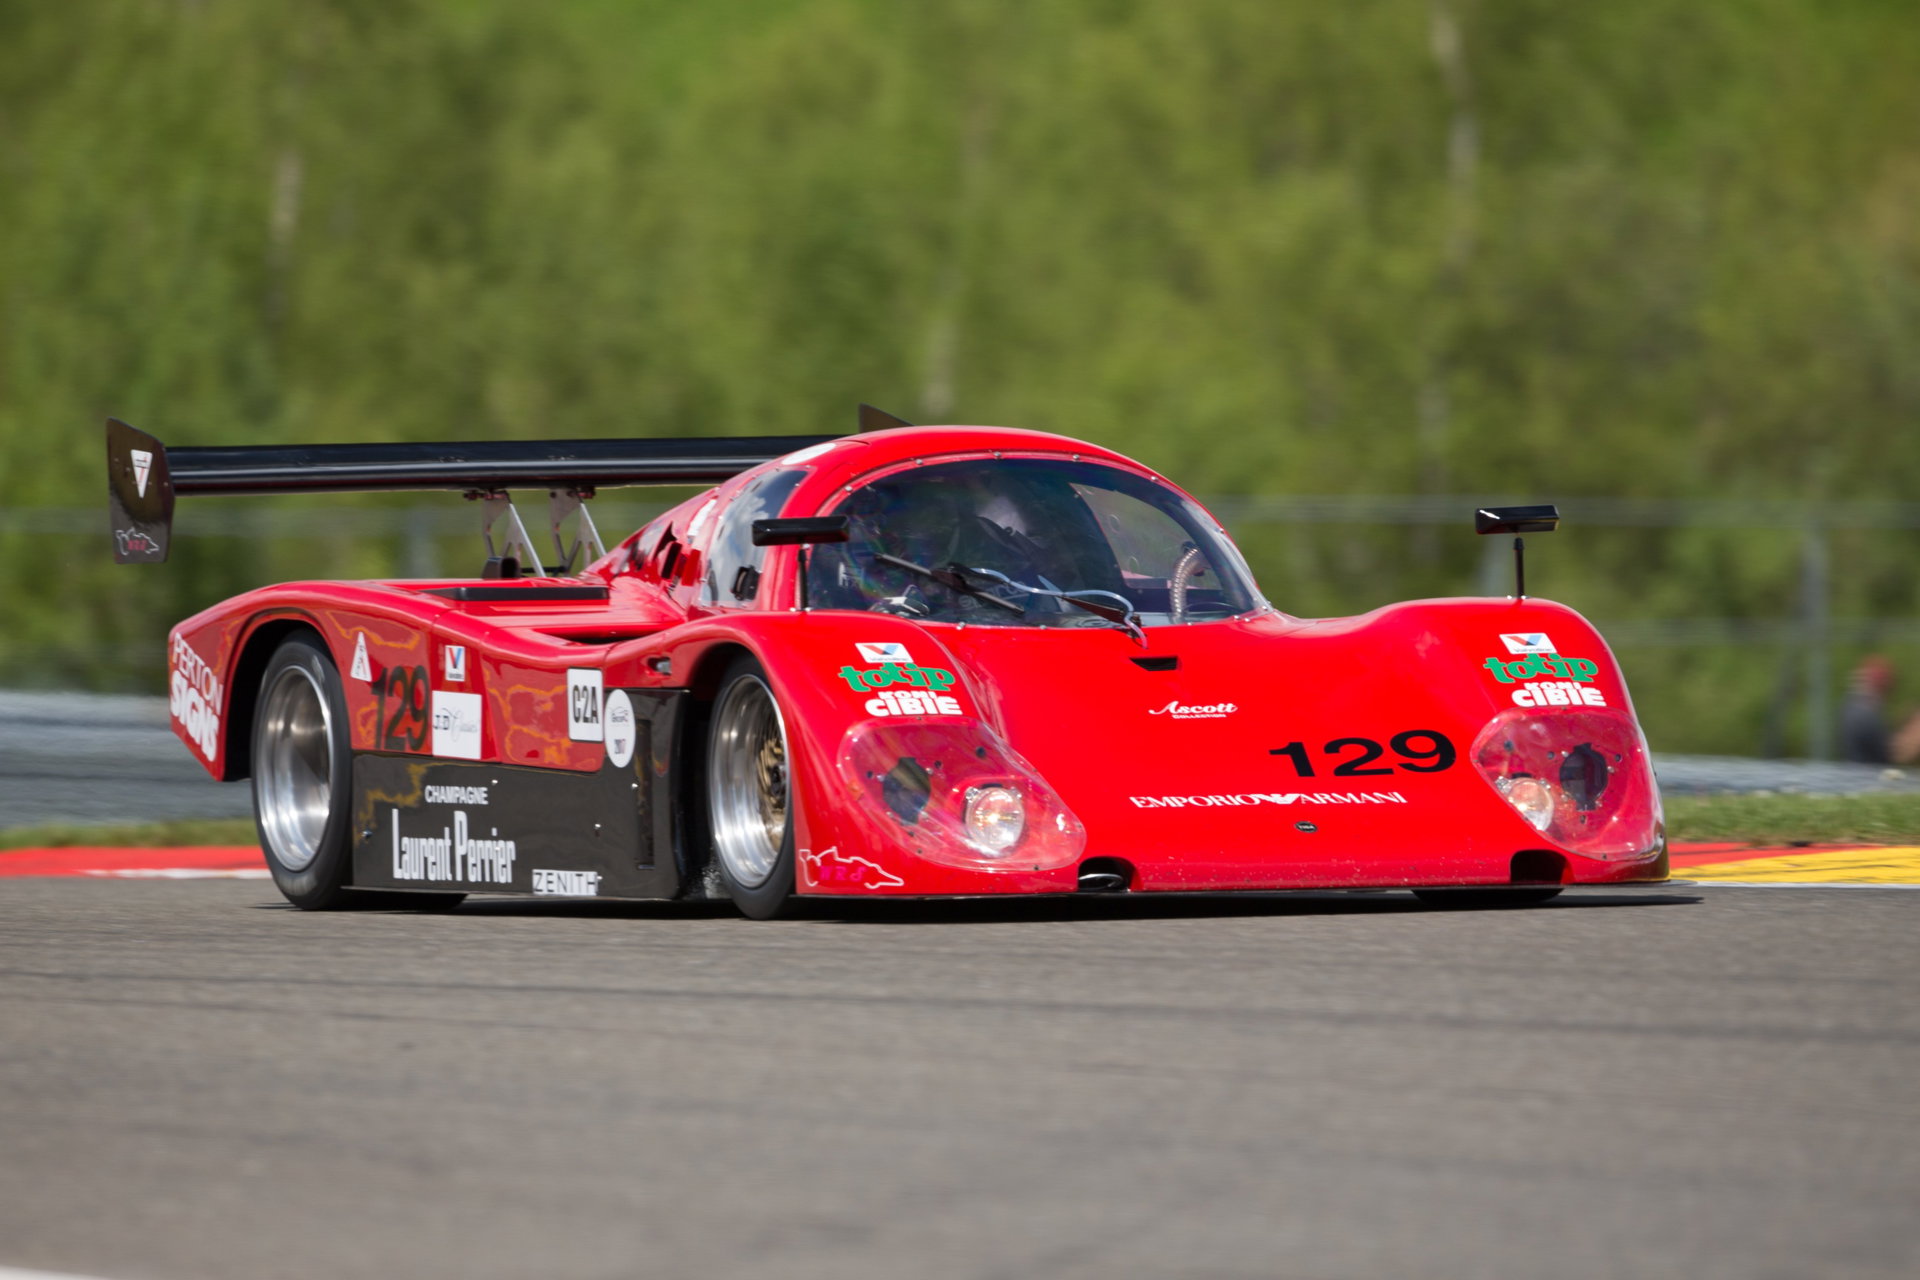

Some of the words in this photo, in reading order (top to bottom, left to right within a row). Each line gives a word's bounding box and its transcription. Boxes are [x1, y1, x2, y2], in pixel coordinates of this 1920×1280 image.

[173, 632, 224, 716] PERTON
[838, 662, 956, 692] totip
[1483, 653, 1599, 684] totip
[370, 665, 429, 751] 129
[572, 685, 600, 724] C2A
[865, 695, 963, 717] CIBIE
[1148, 700, 1239, 715] Ascott
[1511, 686, 1607, 708] CIBIE
[171, 670, 220, 762] SIGNS
[1268, 729, 1456, 778] 129
[425, 785, 489, 805] CHAMPAGNE
[1129, 793, 1259, 808] EMPORIO
[1300, 791, 1408, 804] ARMANI
[392, 808, 452, 881] Laurent
[453, 810, 517, 884] Perrier
[533, 871, 597, 893] ZENITH
